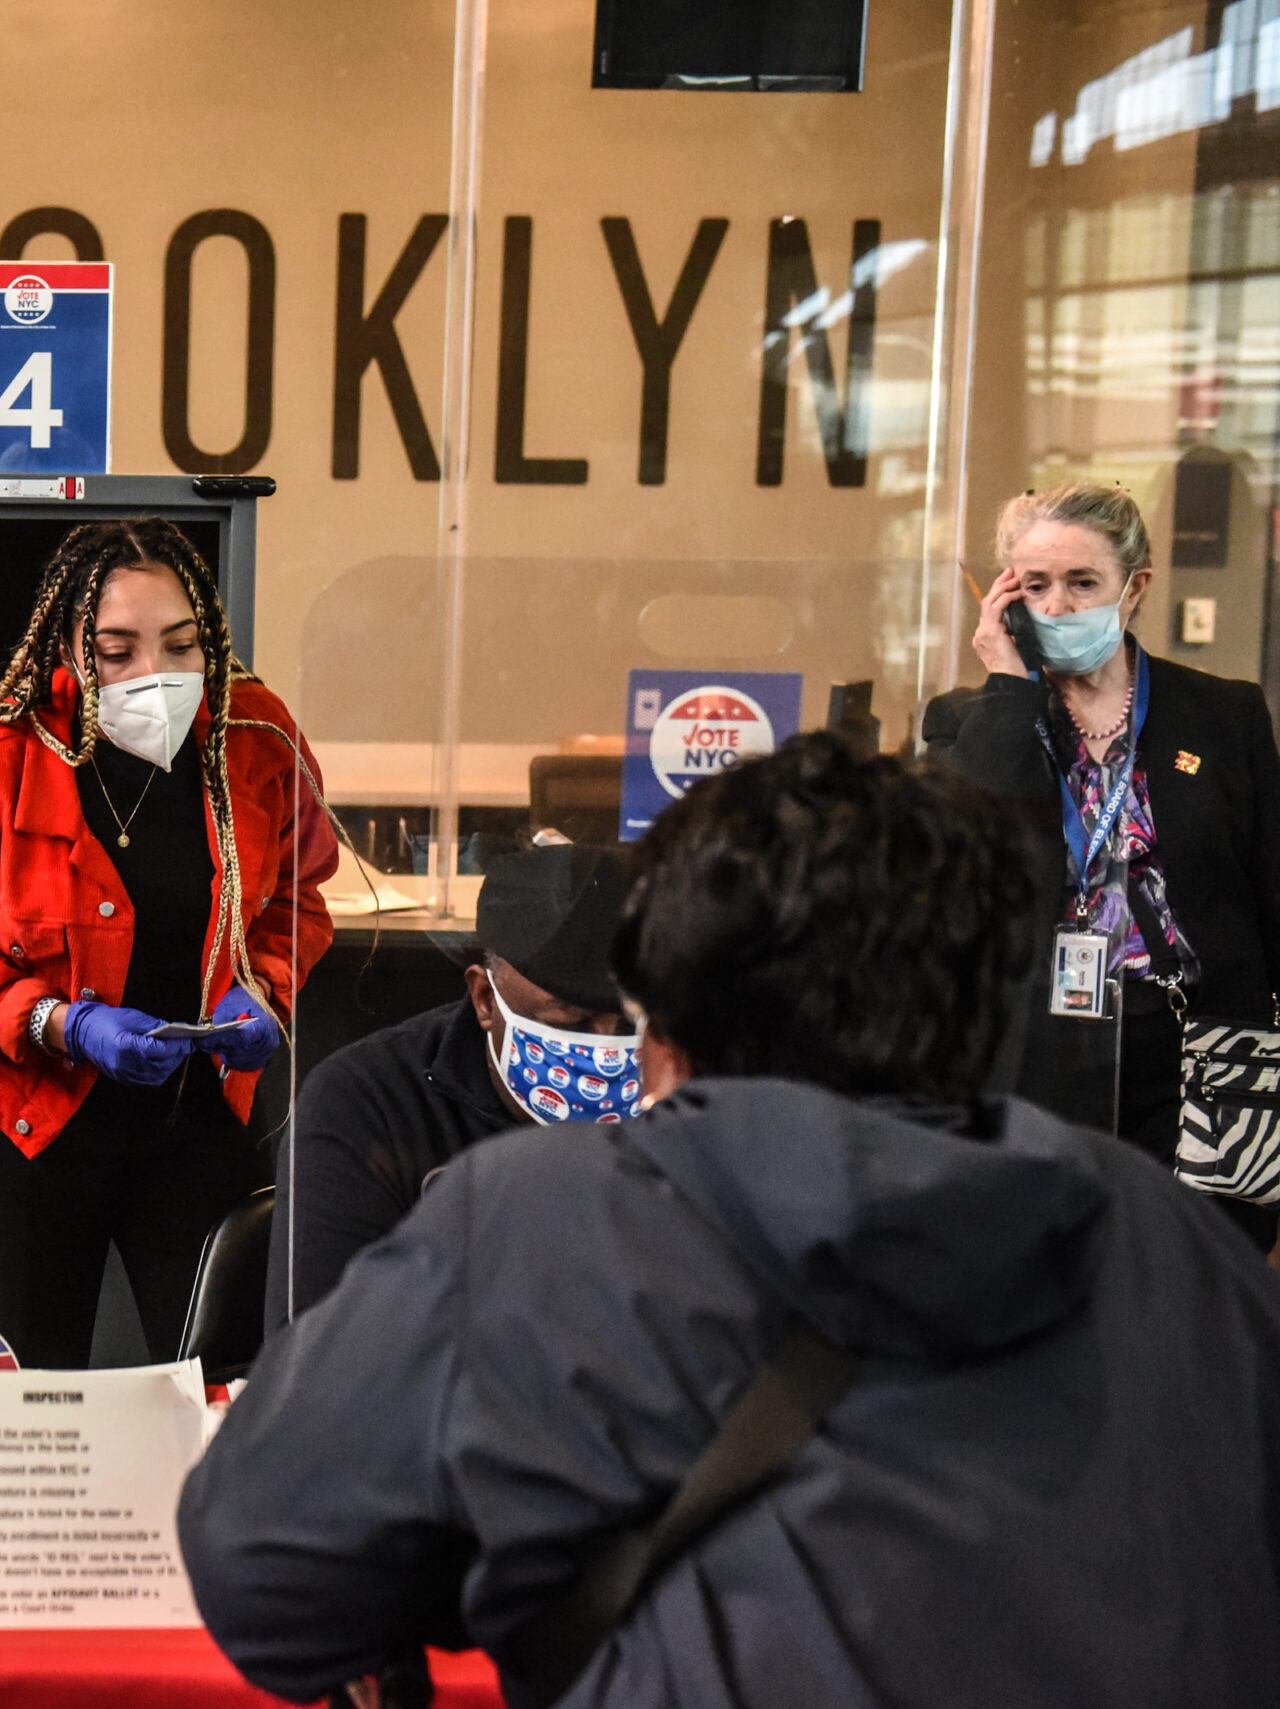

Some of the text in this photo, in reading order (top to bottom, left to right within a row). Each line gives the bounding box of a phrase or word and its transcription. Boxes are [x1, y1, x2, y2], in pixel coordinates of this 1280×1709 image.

[17, 289, 39, 300] VOTE
[18, 300, 39, 309] NYC
[682, 723, 740, 748] VOTE
[684, 749, 738, 768] NYC
[1106, 780, 1127, 814] BOARD
[1100, 814, 1111, 829] OF
[23, 1391, 84, 1404] INSPECTOR
[3, 1428, 18, 1440] the
[38, 1442, 52, 1453] the
[39, 1487, 76, 1498] missing
[10, 1531, 60, 1542] enrollment
[100, 1531, 149, 1542] incorrectly
[51, 1588, 99, 1599] AFFIDAVIT
[102, 1588, 138, 1599] BALLOT
